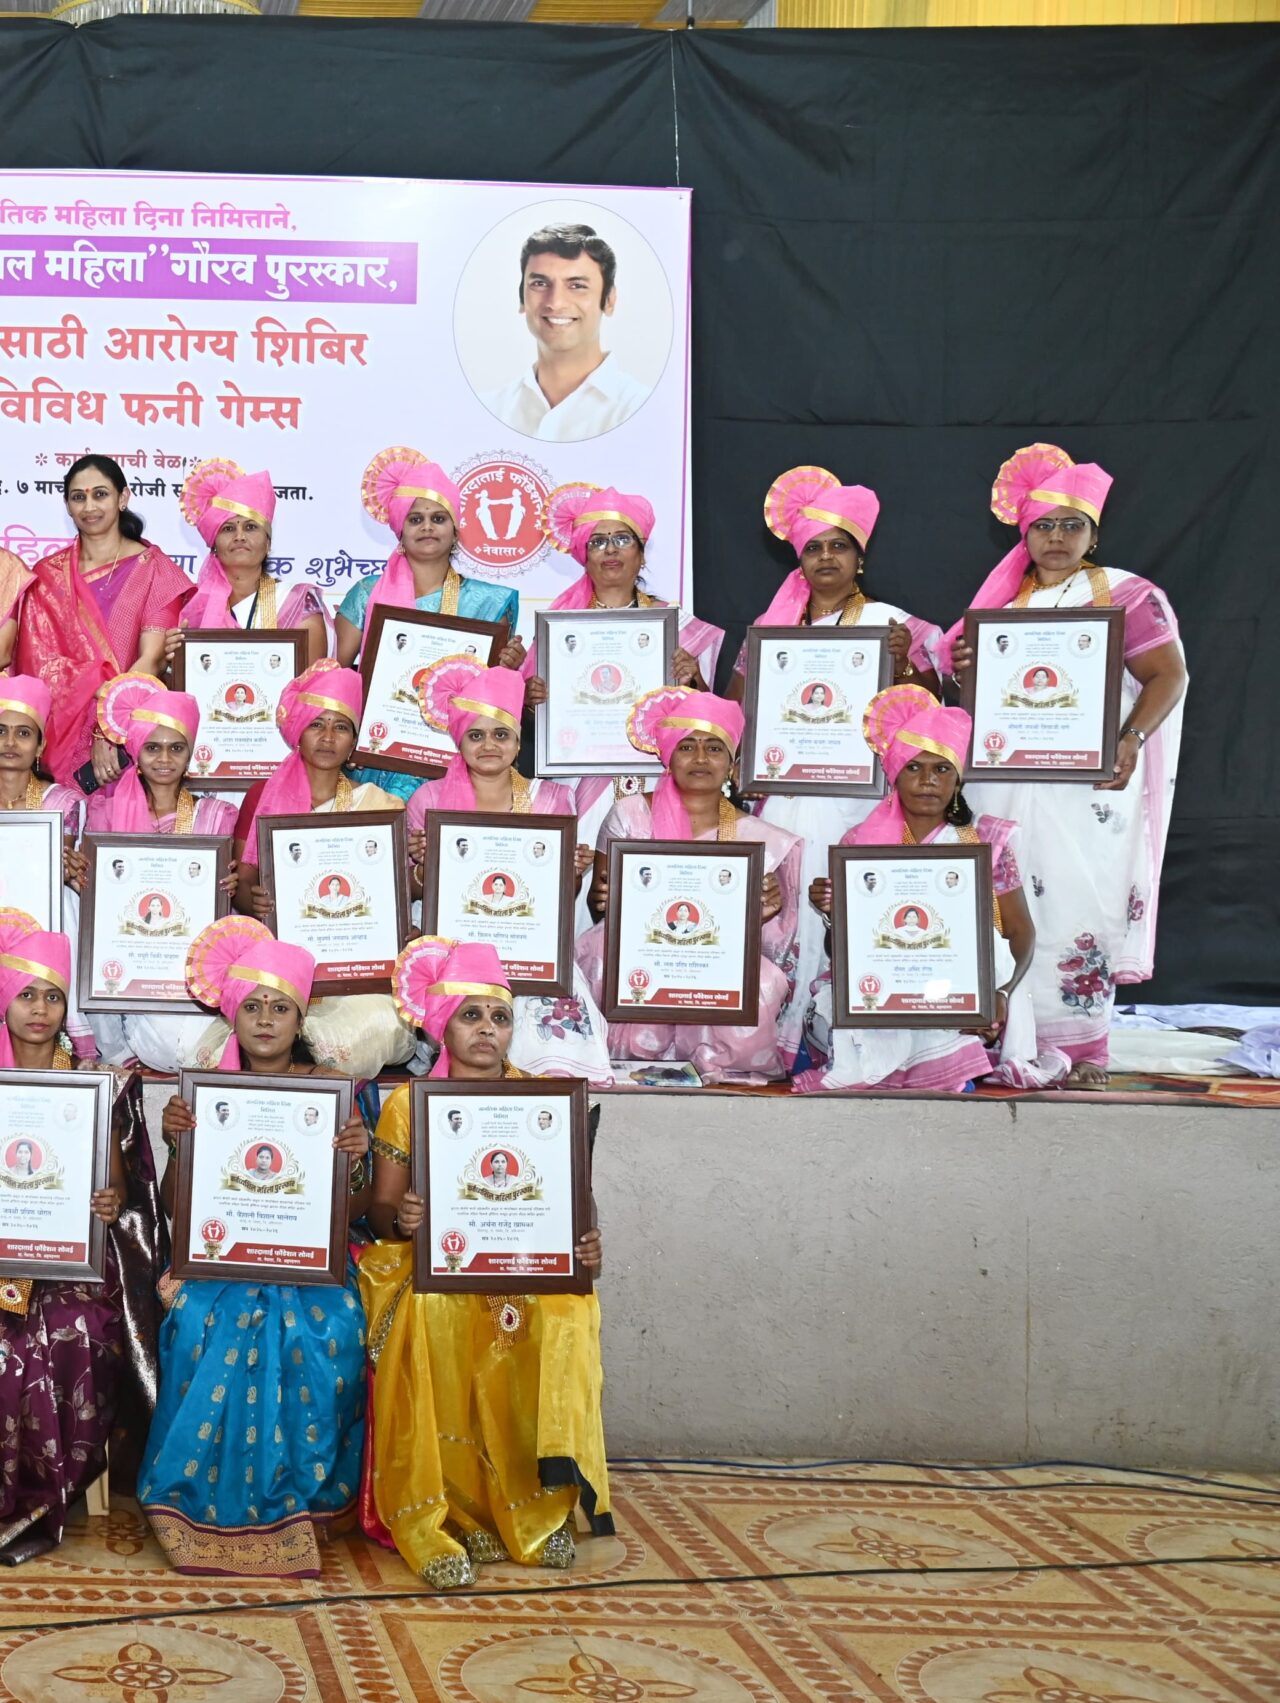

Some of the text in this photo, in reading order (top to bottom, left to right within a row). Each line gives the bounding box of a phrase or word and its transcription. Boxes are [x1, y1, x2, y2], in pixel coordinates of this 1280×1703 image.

[55, 199, 127, 230] महिला
[133, 201, 185, 231] दिना
[191, 202, 297, 232] निमित्ताने,
[265, 254, 397, 300] पुरस्कार,
[104, 314, 238, 363] आरोग्य
[250, 316, 369, 367] शिबिर
[119, 381, 204, 427] फनी
[216, 380, 302, 430] गेम्स
[16, 480, 29, 494] ७
[129, 476, 166, 497] रोजी
[483, 544, 517, 556] नेवासा
